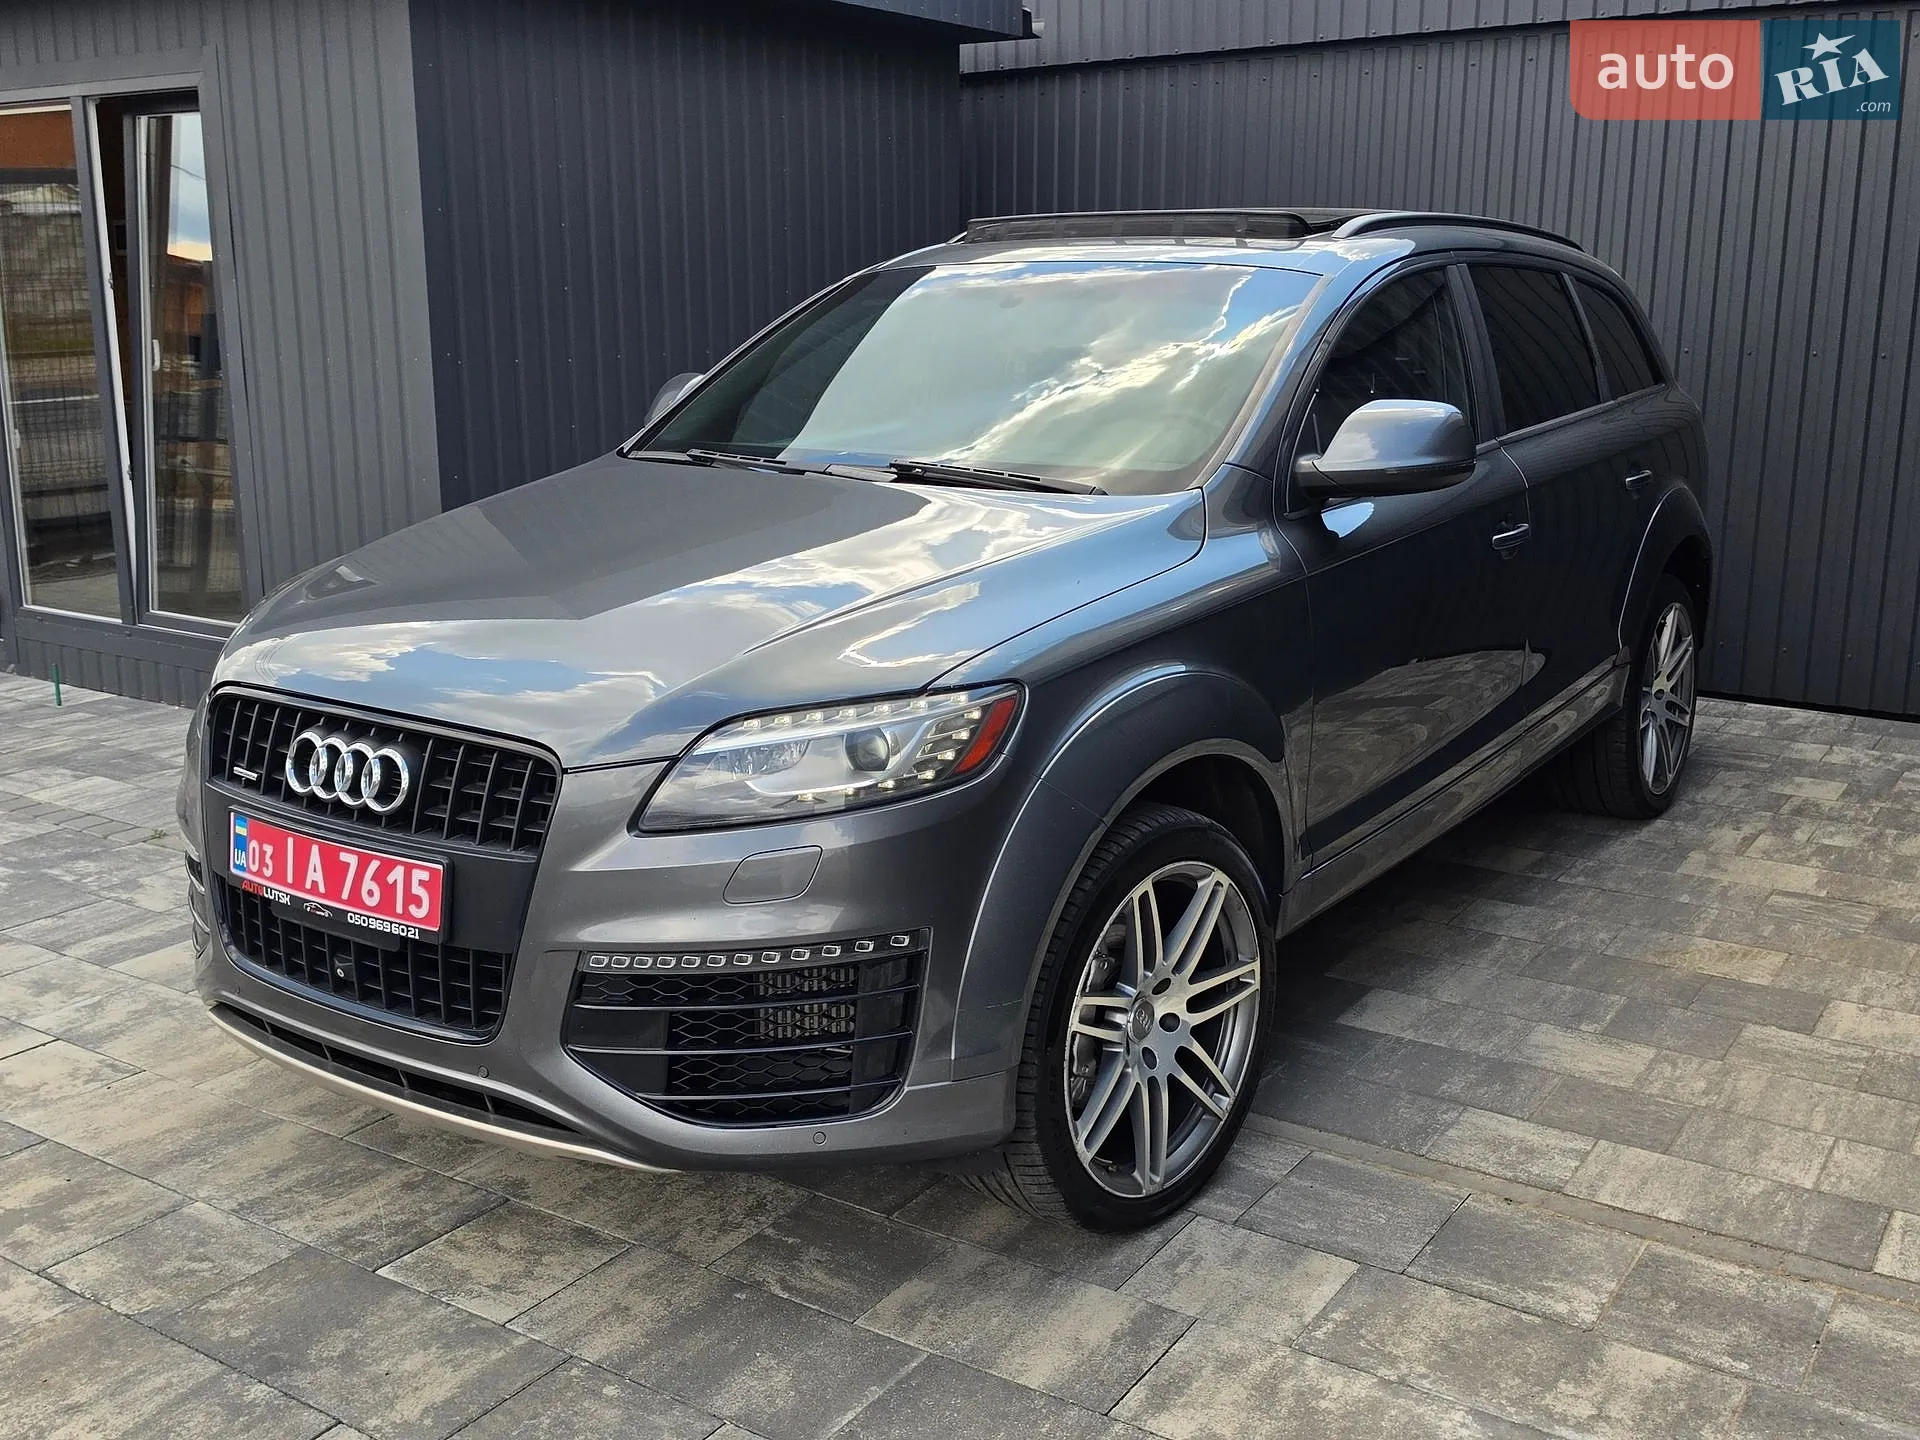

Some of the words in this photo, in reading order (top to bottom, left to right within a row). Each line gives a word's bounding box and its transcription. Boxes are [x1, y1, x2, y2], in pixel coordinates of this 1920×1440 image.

[235, 848, 247, 868] UA
[249, 839, 274, 878] 03
[287, 837, 326, 894] IA
[339, 851, 430, 919] 7615
